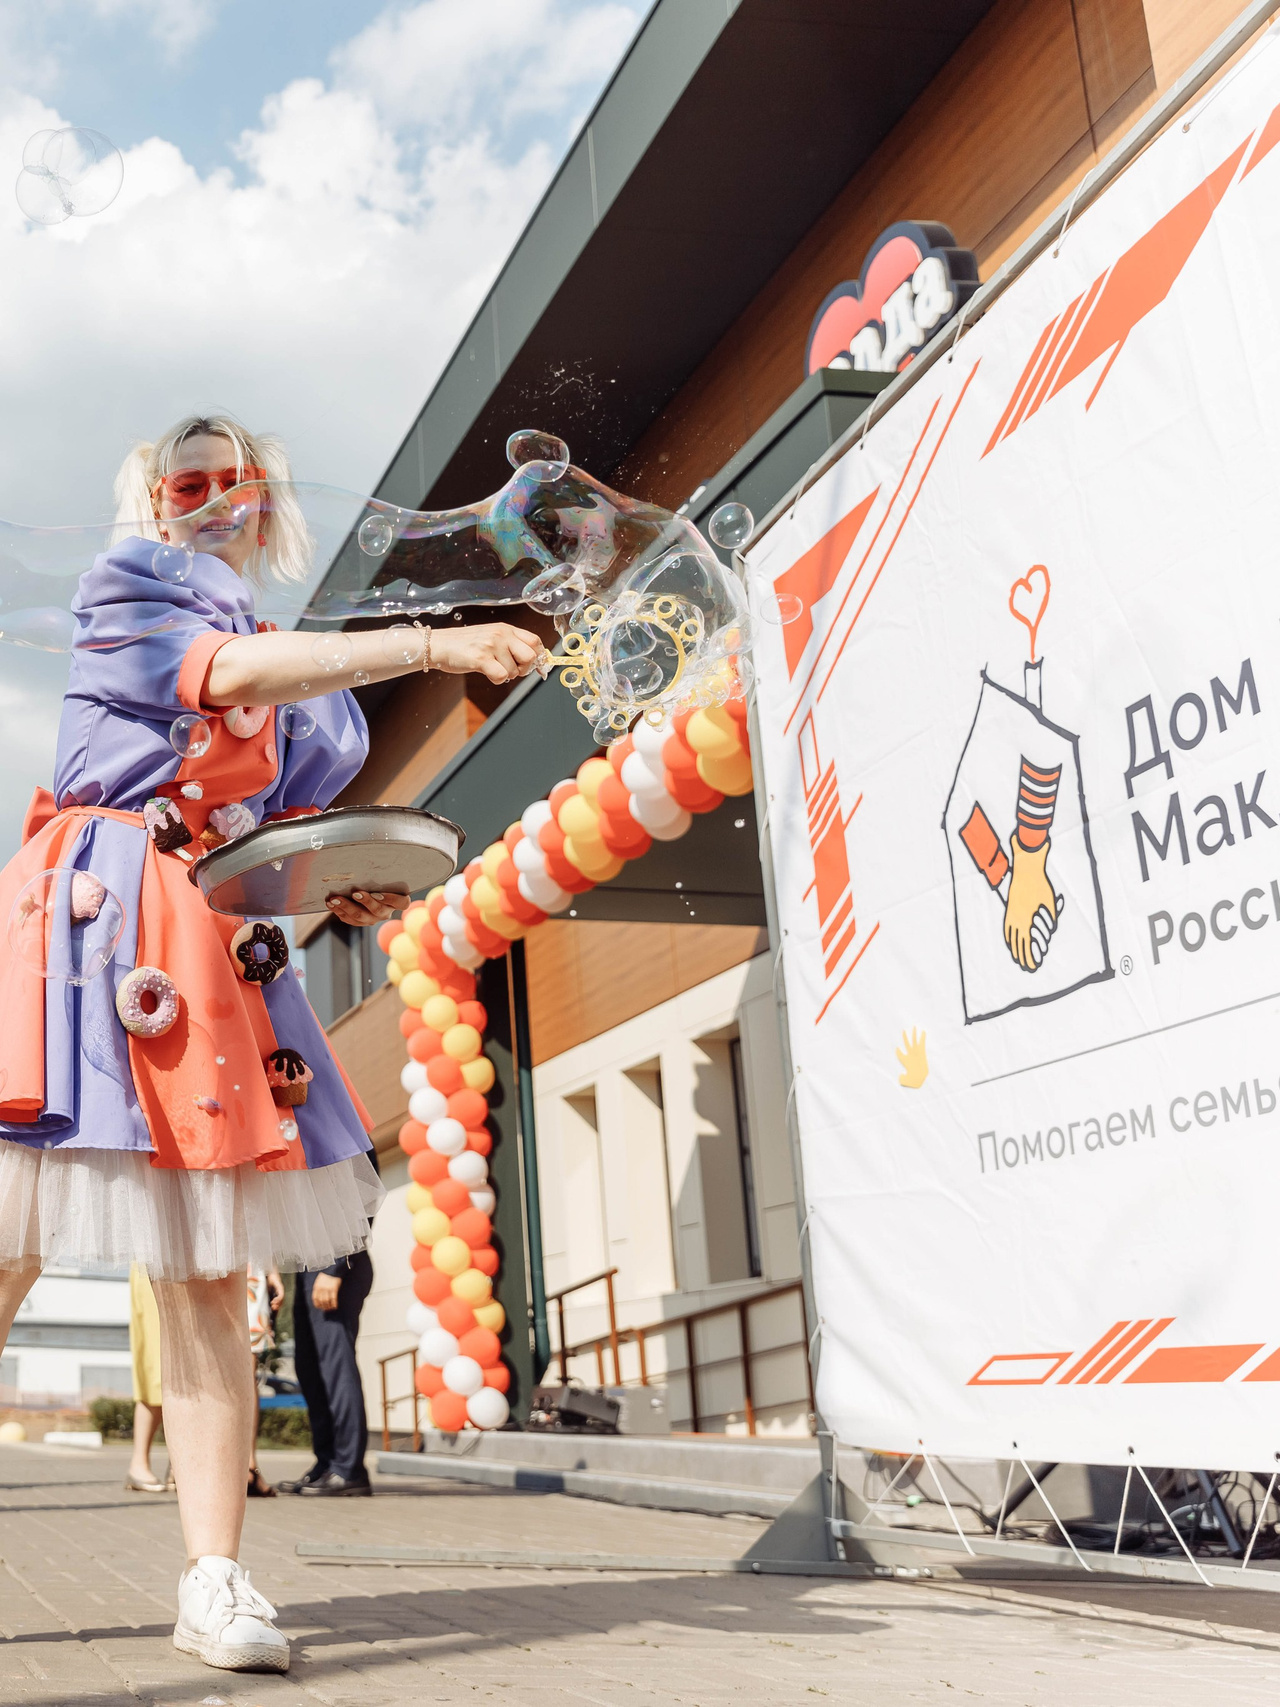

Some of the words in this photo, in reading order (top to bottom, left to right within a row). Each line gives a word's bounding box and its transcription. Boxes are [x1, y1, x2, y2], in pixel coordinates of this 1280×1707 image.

[1123, 657, 1261, 800] Дом
[1130, 769, 1280, 883] Мак
[977, 1104, 1156, 1174] Помогаем
[1169, 1078, 1280, 1133] семь
